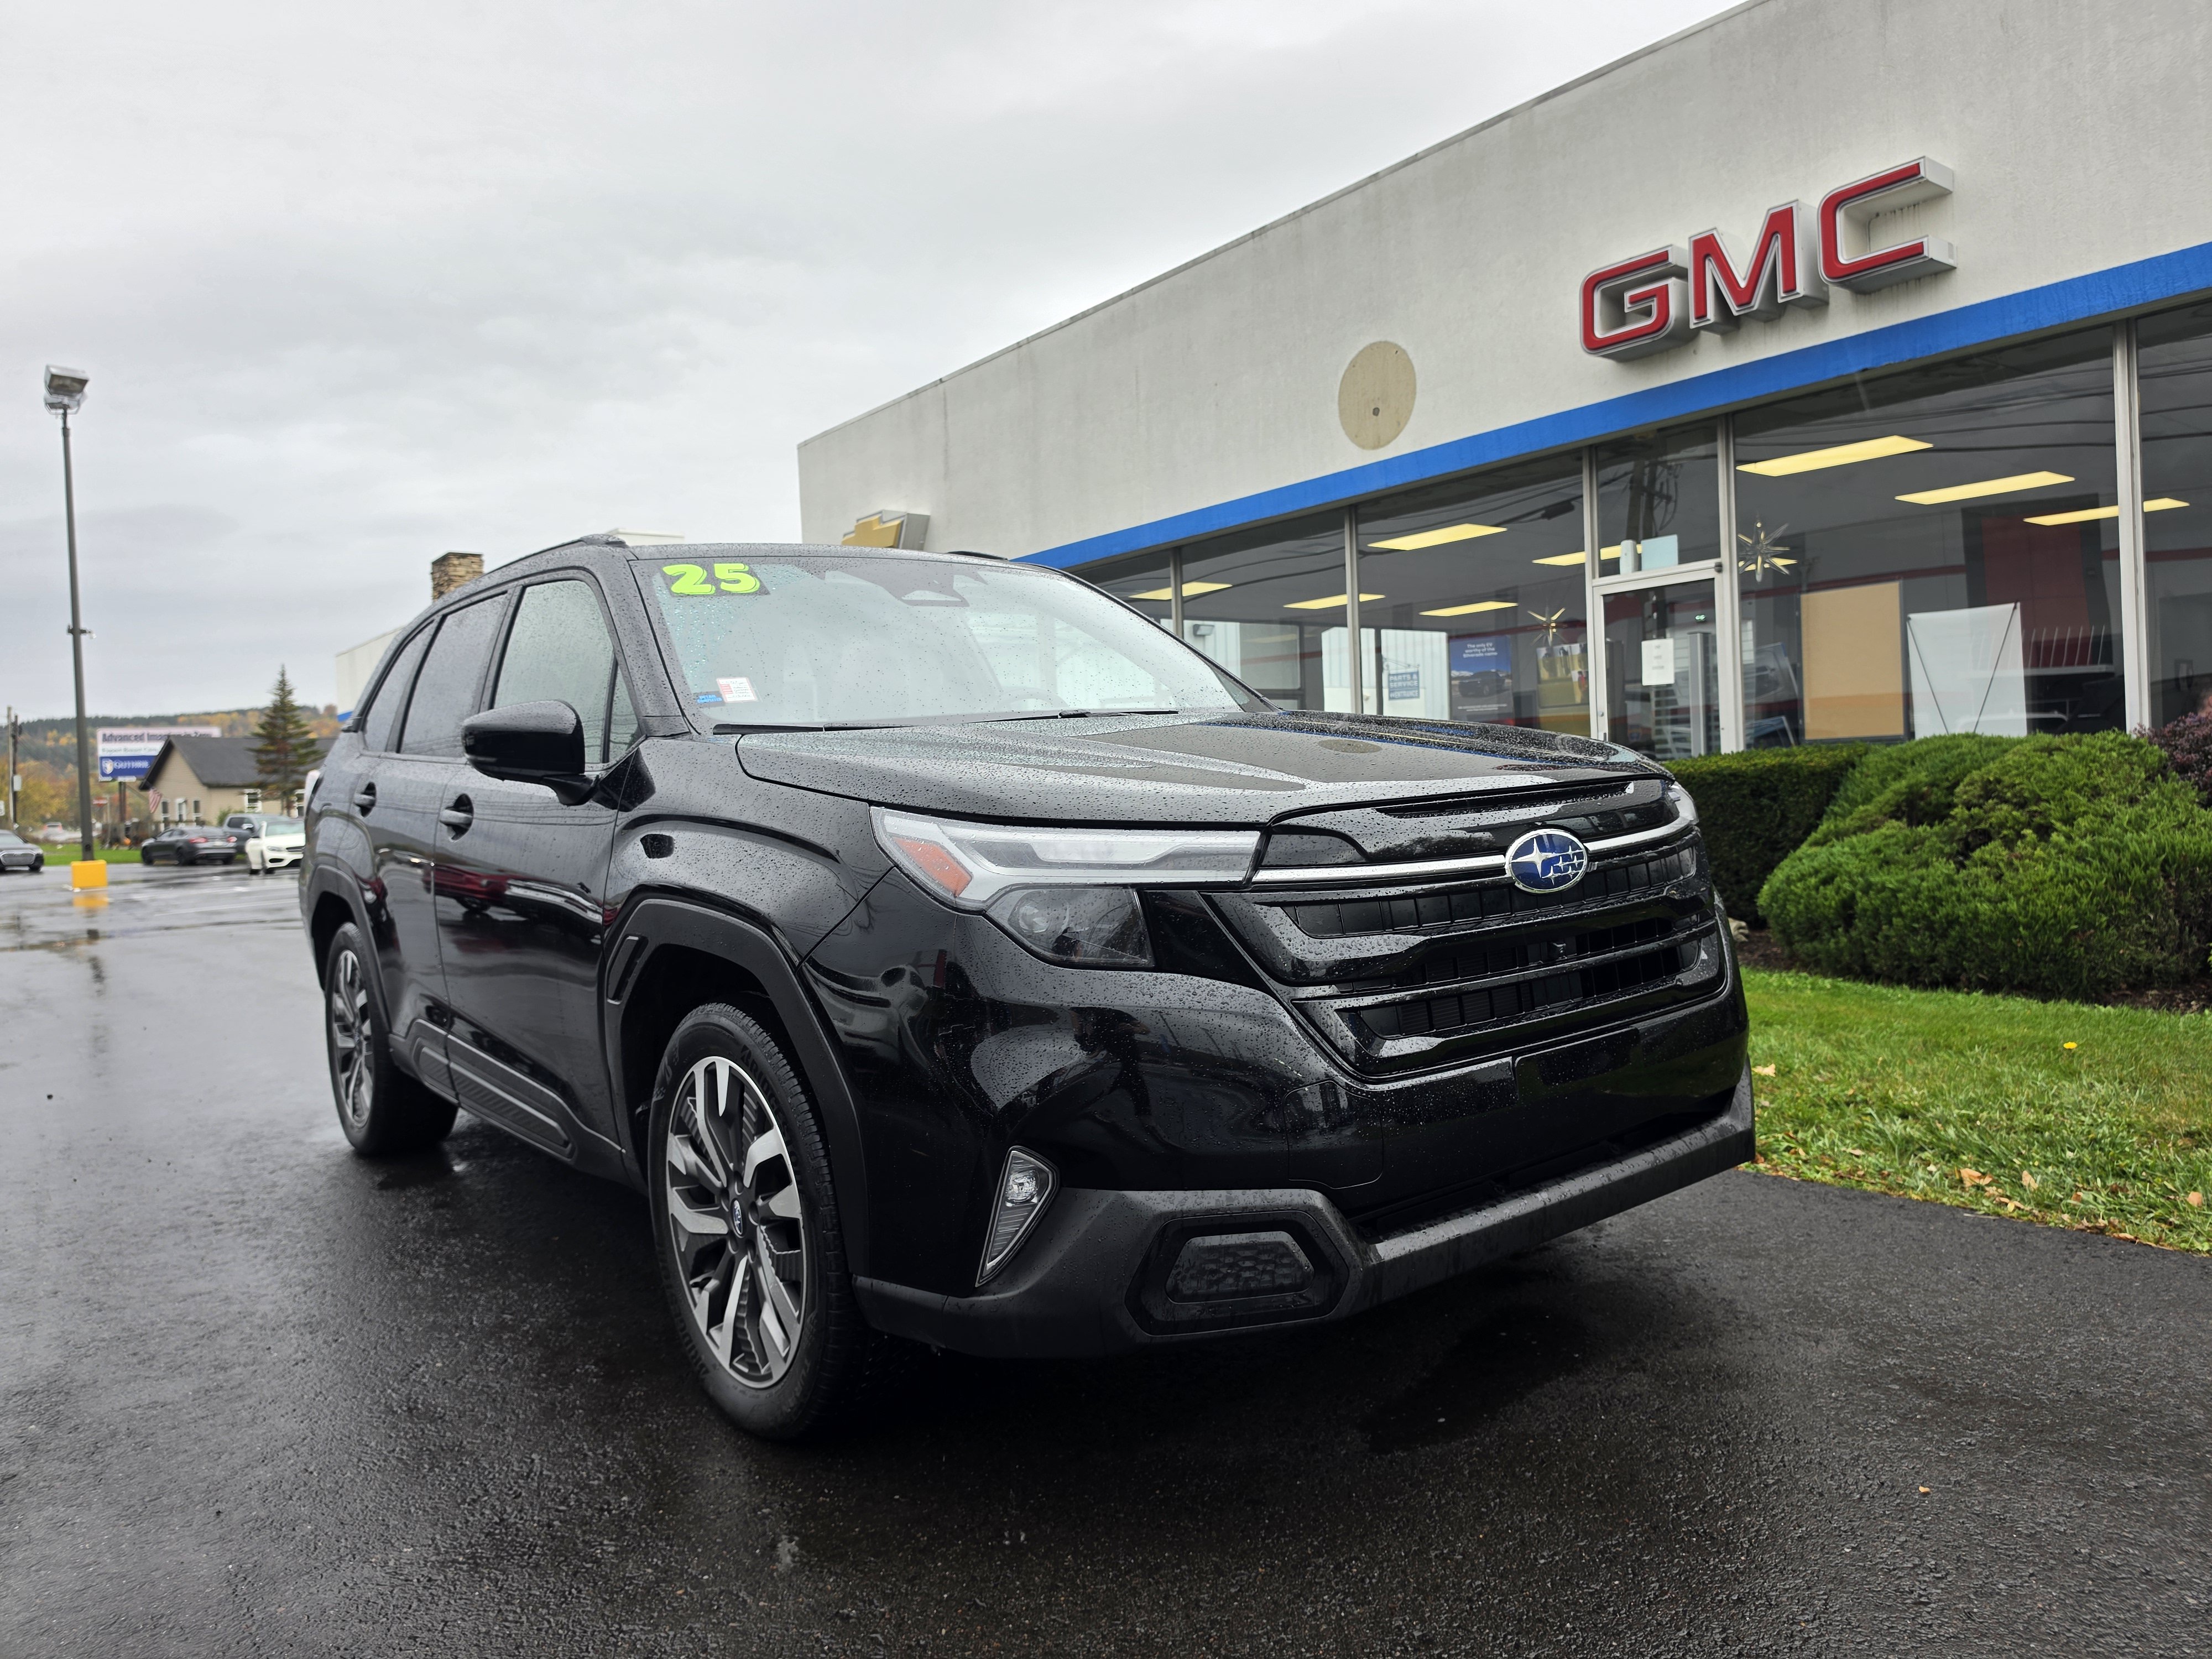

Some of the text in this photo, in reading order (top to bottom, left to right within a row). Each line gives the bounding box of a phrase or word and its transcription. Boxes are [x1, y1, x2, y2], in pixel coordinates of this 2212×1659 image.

[1580, 155, 1930, 357] GMC
[662, 563, 760, 595] 25
[102, 733, 145, 743] Advanced
